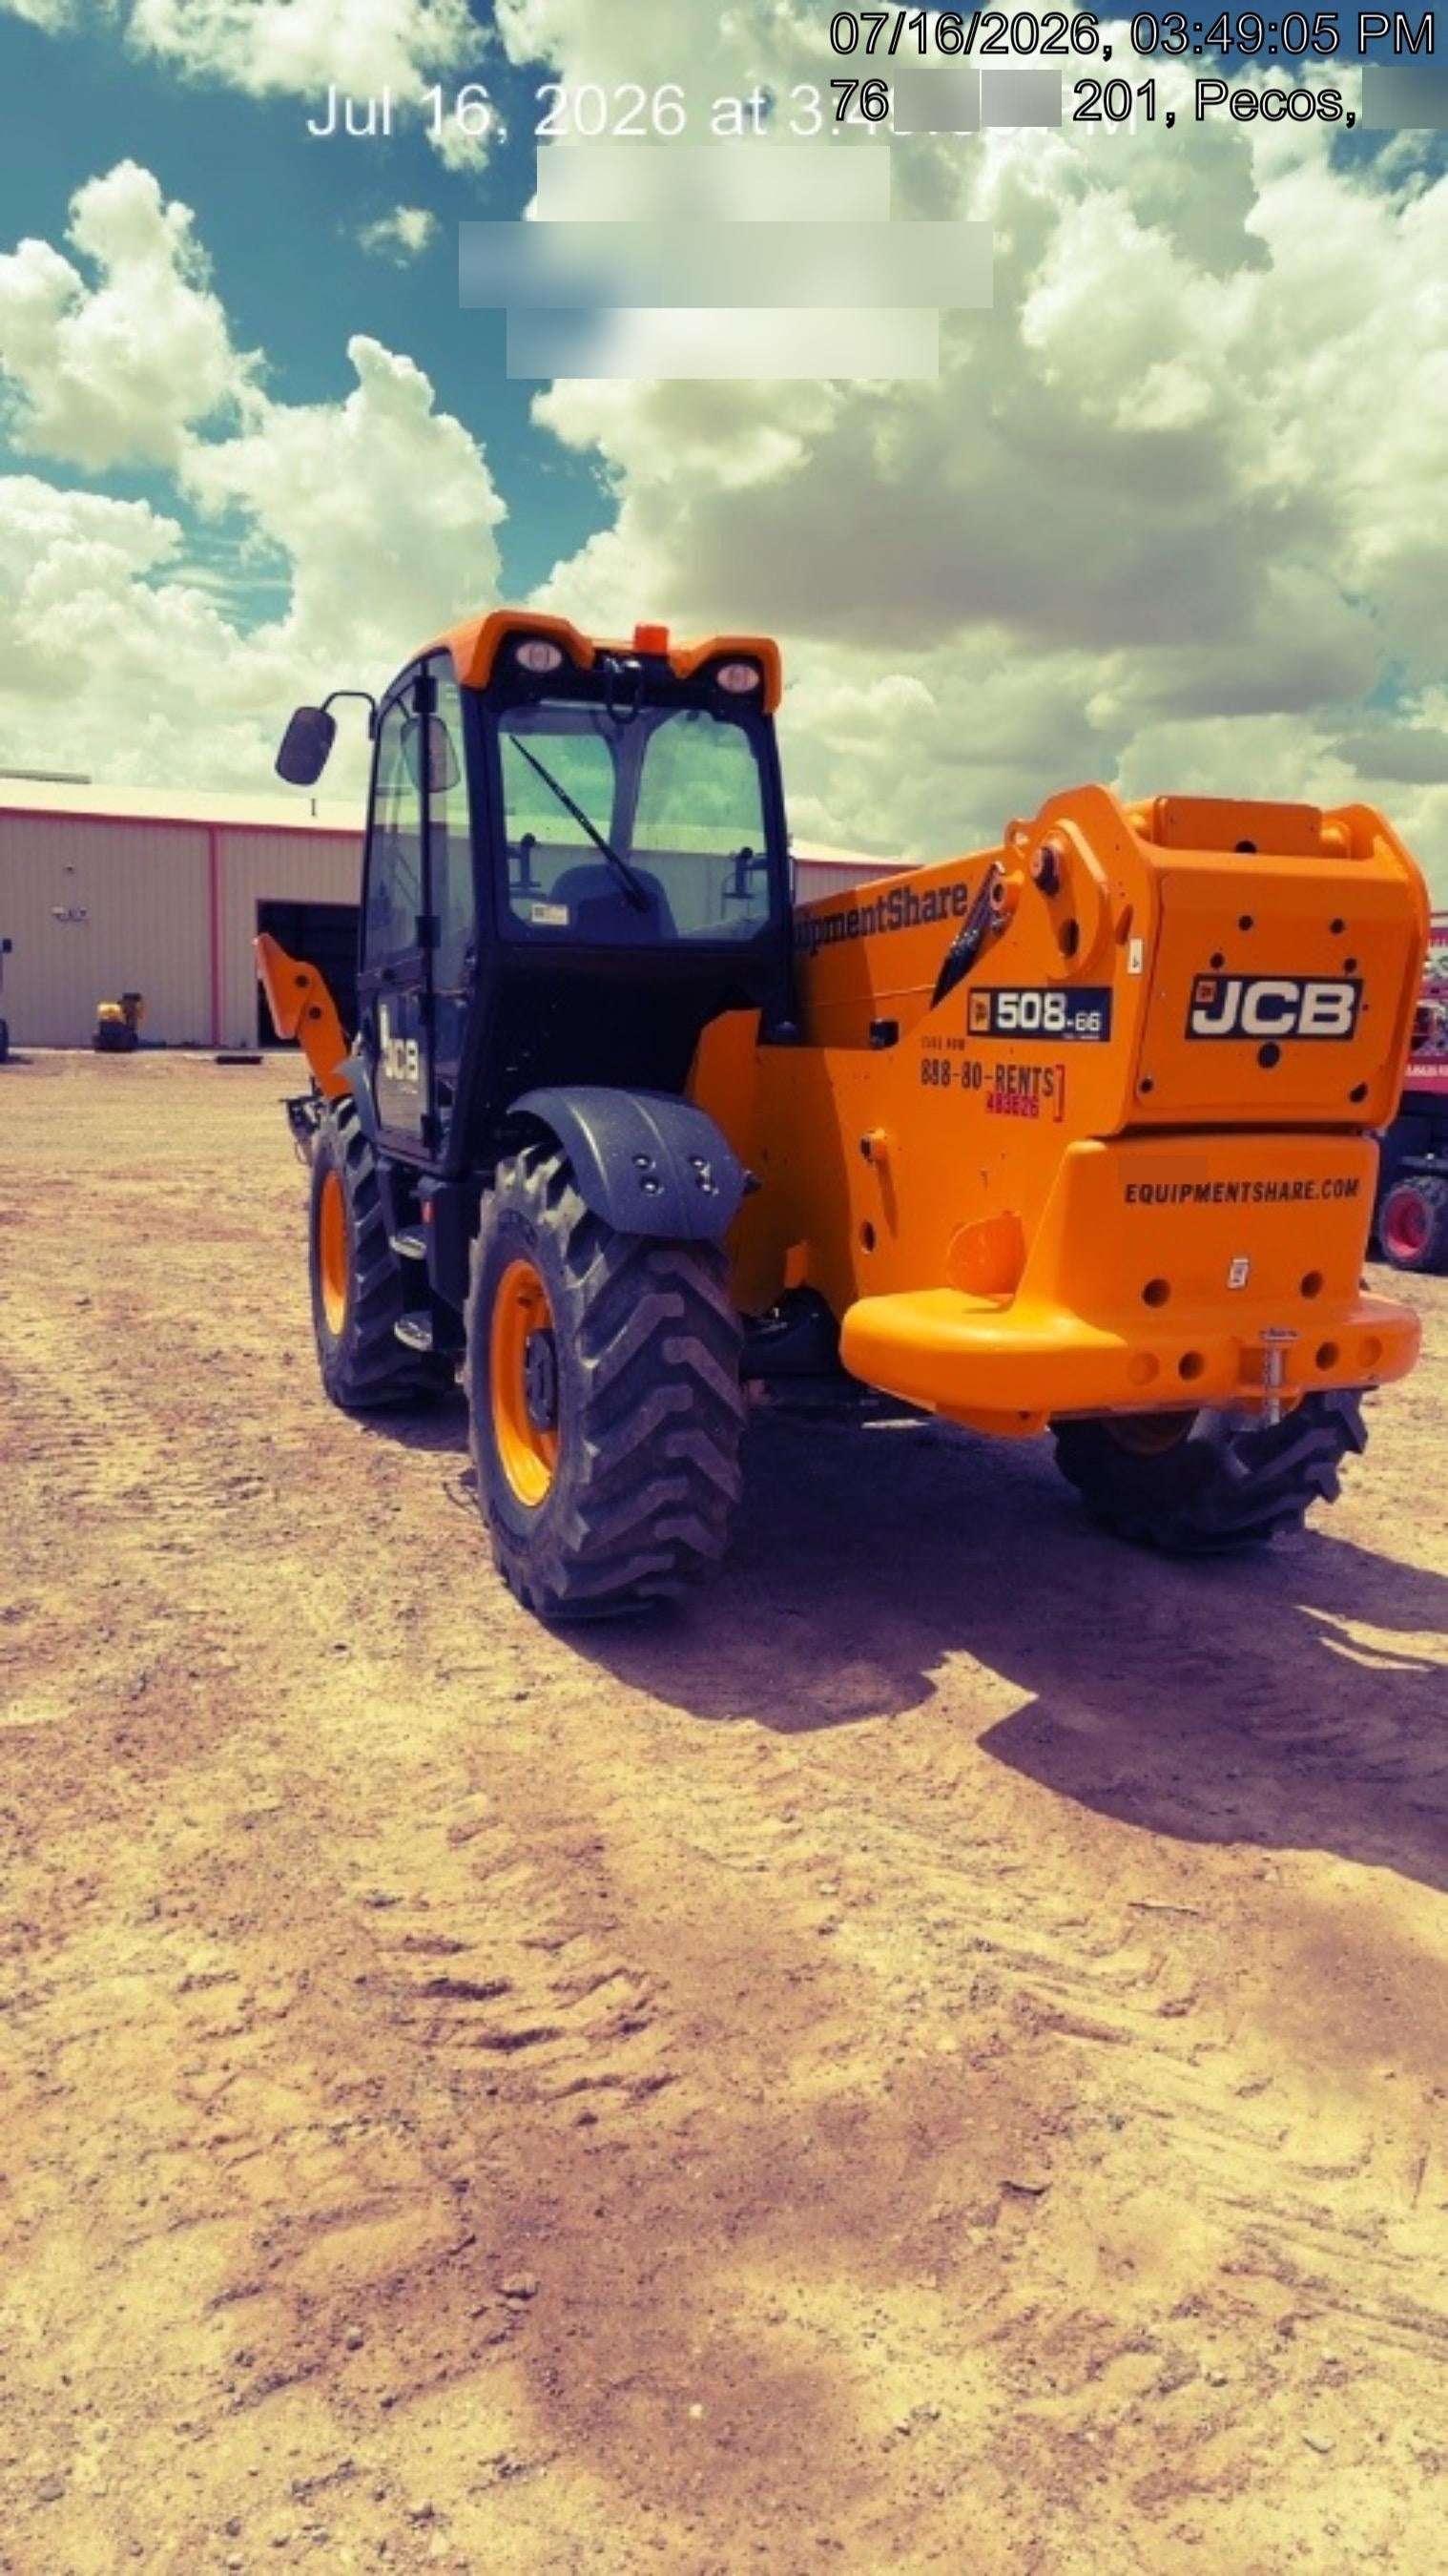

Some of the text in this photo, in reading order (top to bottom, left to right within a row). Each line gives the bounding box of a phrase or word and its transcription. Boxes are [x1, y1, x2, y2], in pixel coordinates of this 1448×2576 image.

[1191, 981, 1355, 1035] JCB
[921, 1057, 1054, 1097] 888-80-RENTS
[1125, 1177, 1360, 1204] EQUIPMENTSHARE.COM
